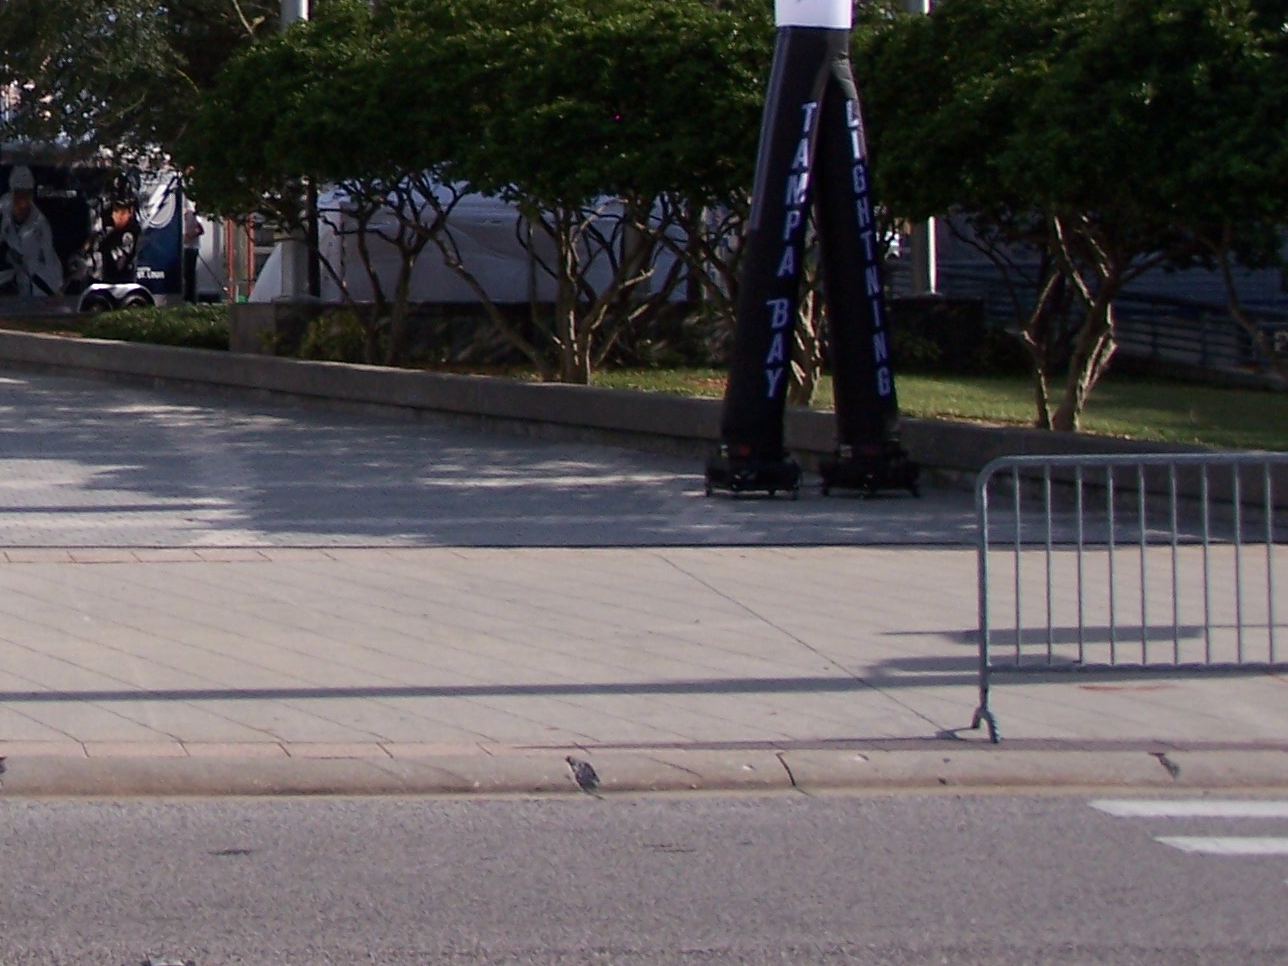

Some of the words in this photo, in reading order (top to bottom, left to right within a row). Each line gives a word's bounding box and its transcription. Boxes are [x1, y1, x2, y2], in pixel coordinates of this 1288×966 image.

[778, 101, 818, 278] TAMPA
[846, 98, 892, 397] LIGHTNING
[764, 299, 790, 398] BAY
